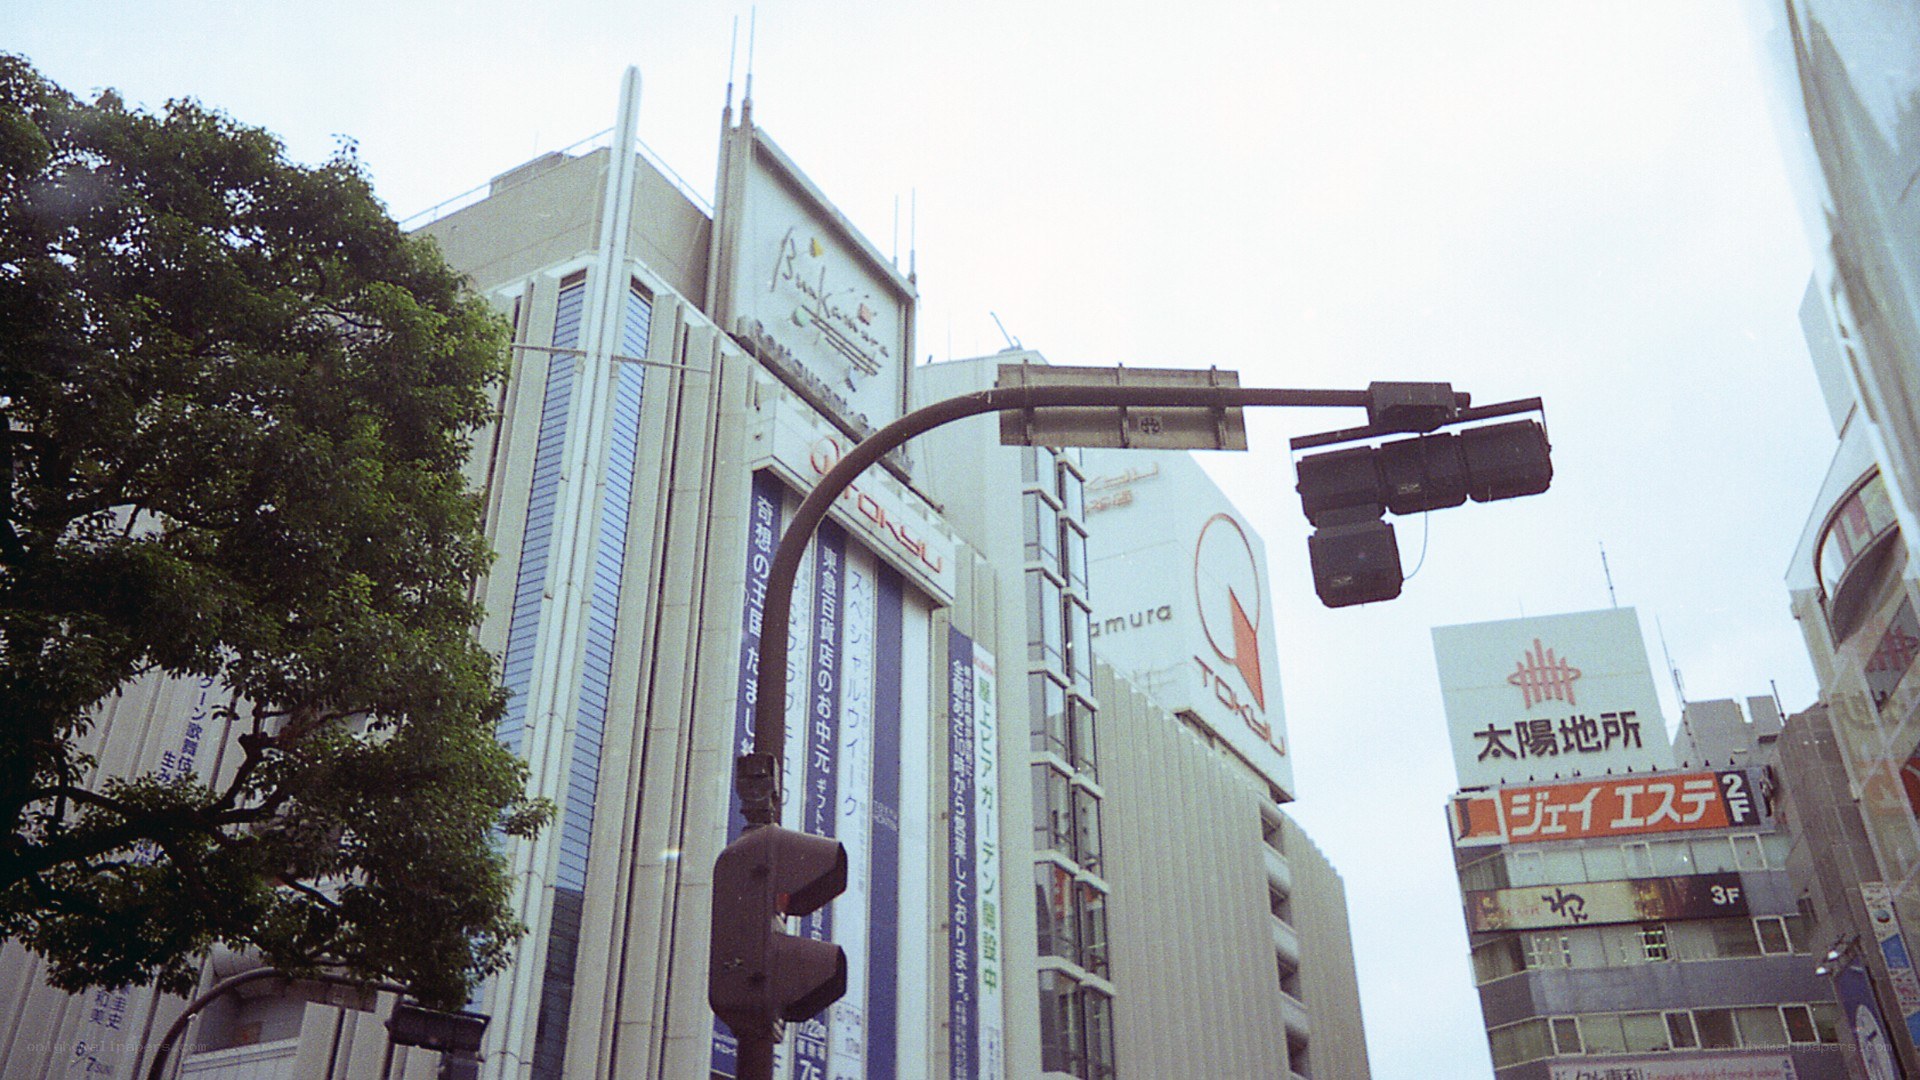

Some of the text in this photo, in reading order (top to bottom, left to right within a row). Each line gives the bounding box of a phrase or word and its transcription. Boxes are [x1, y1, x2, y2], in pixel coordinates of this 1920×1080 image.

[1194, 655, 1286, 757] TOKYU
[1473, 710, 1644, 762] 太陽地所
[1721, 773, 1751, 824] 2F
[1711, 885, 1740, 906] 3F
